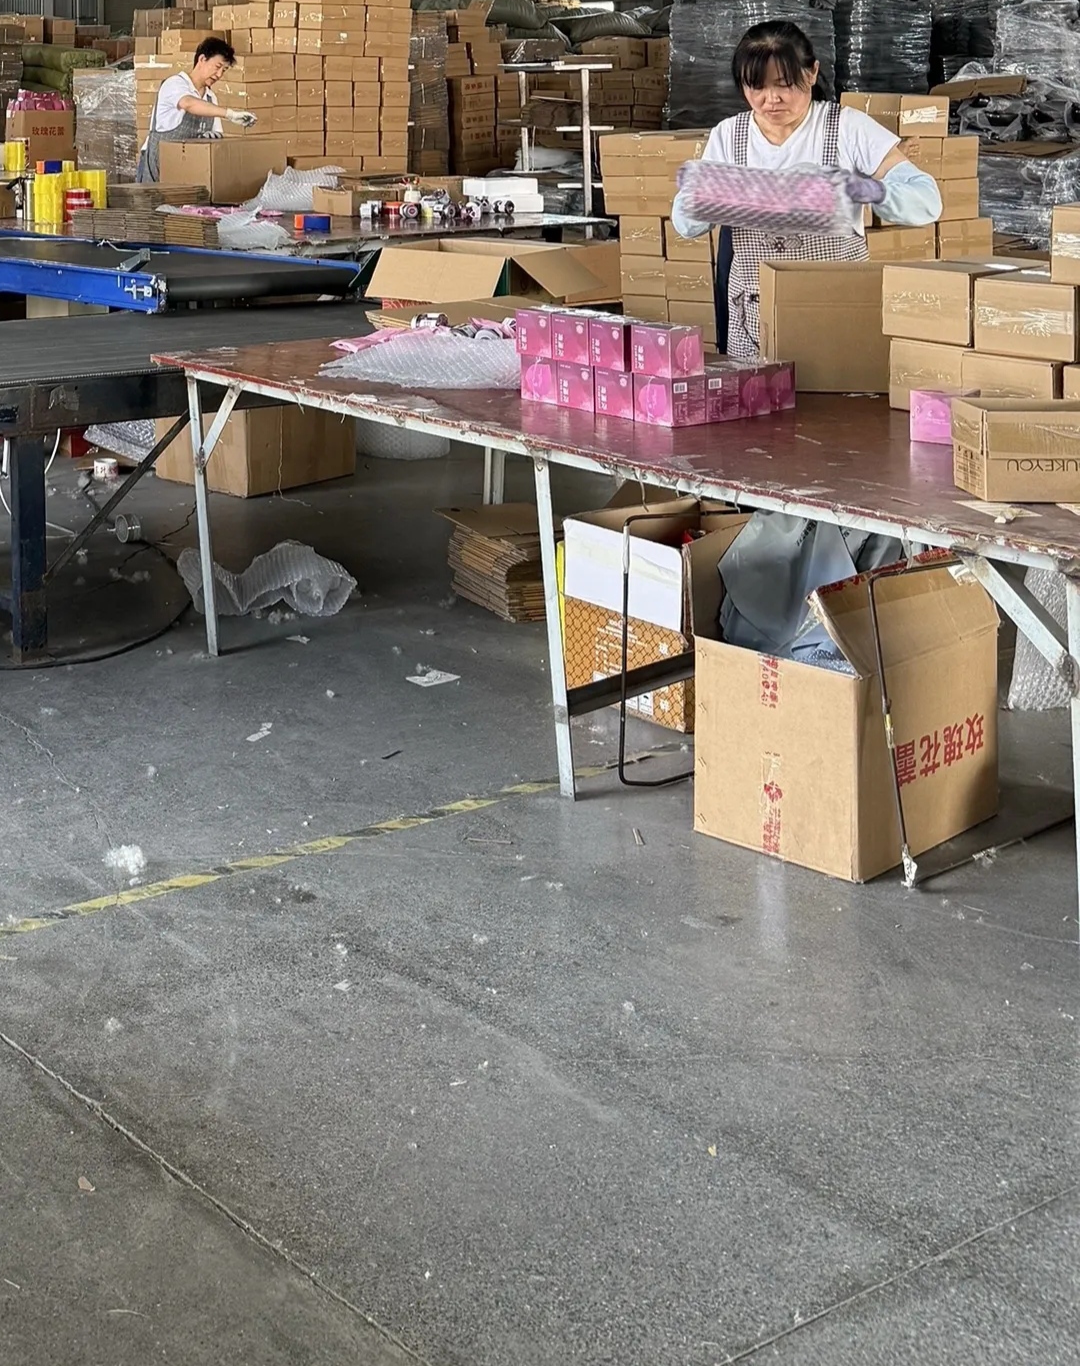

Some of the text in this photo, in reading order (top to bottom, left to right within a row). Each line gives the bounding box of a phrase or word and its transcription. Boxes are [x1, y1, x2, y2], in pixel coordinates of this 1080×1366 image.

[1006, 458, 1080, 472] UKEYOU
[896, 712, 985, 788] 玫瑰花蕾
